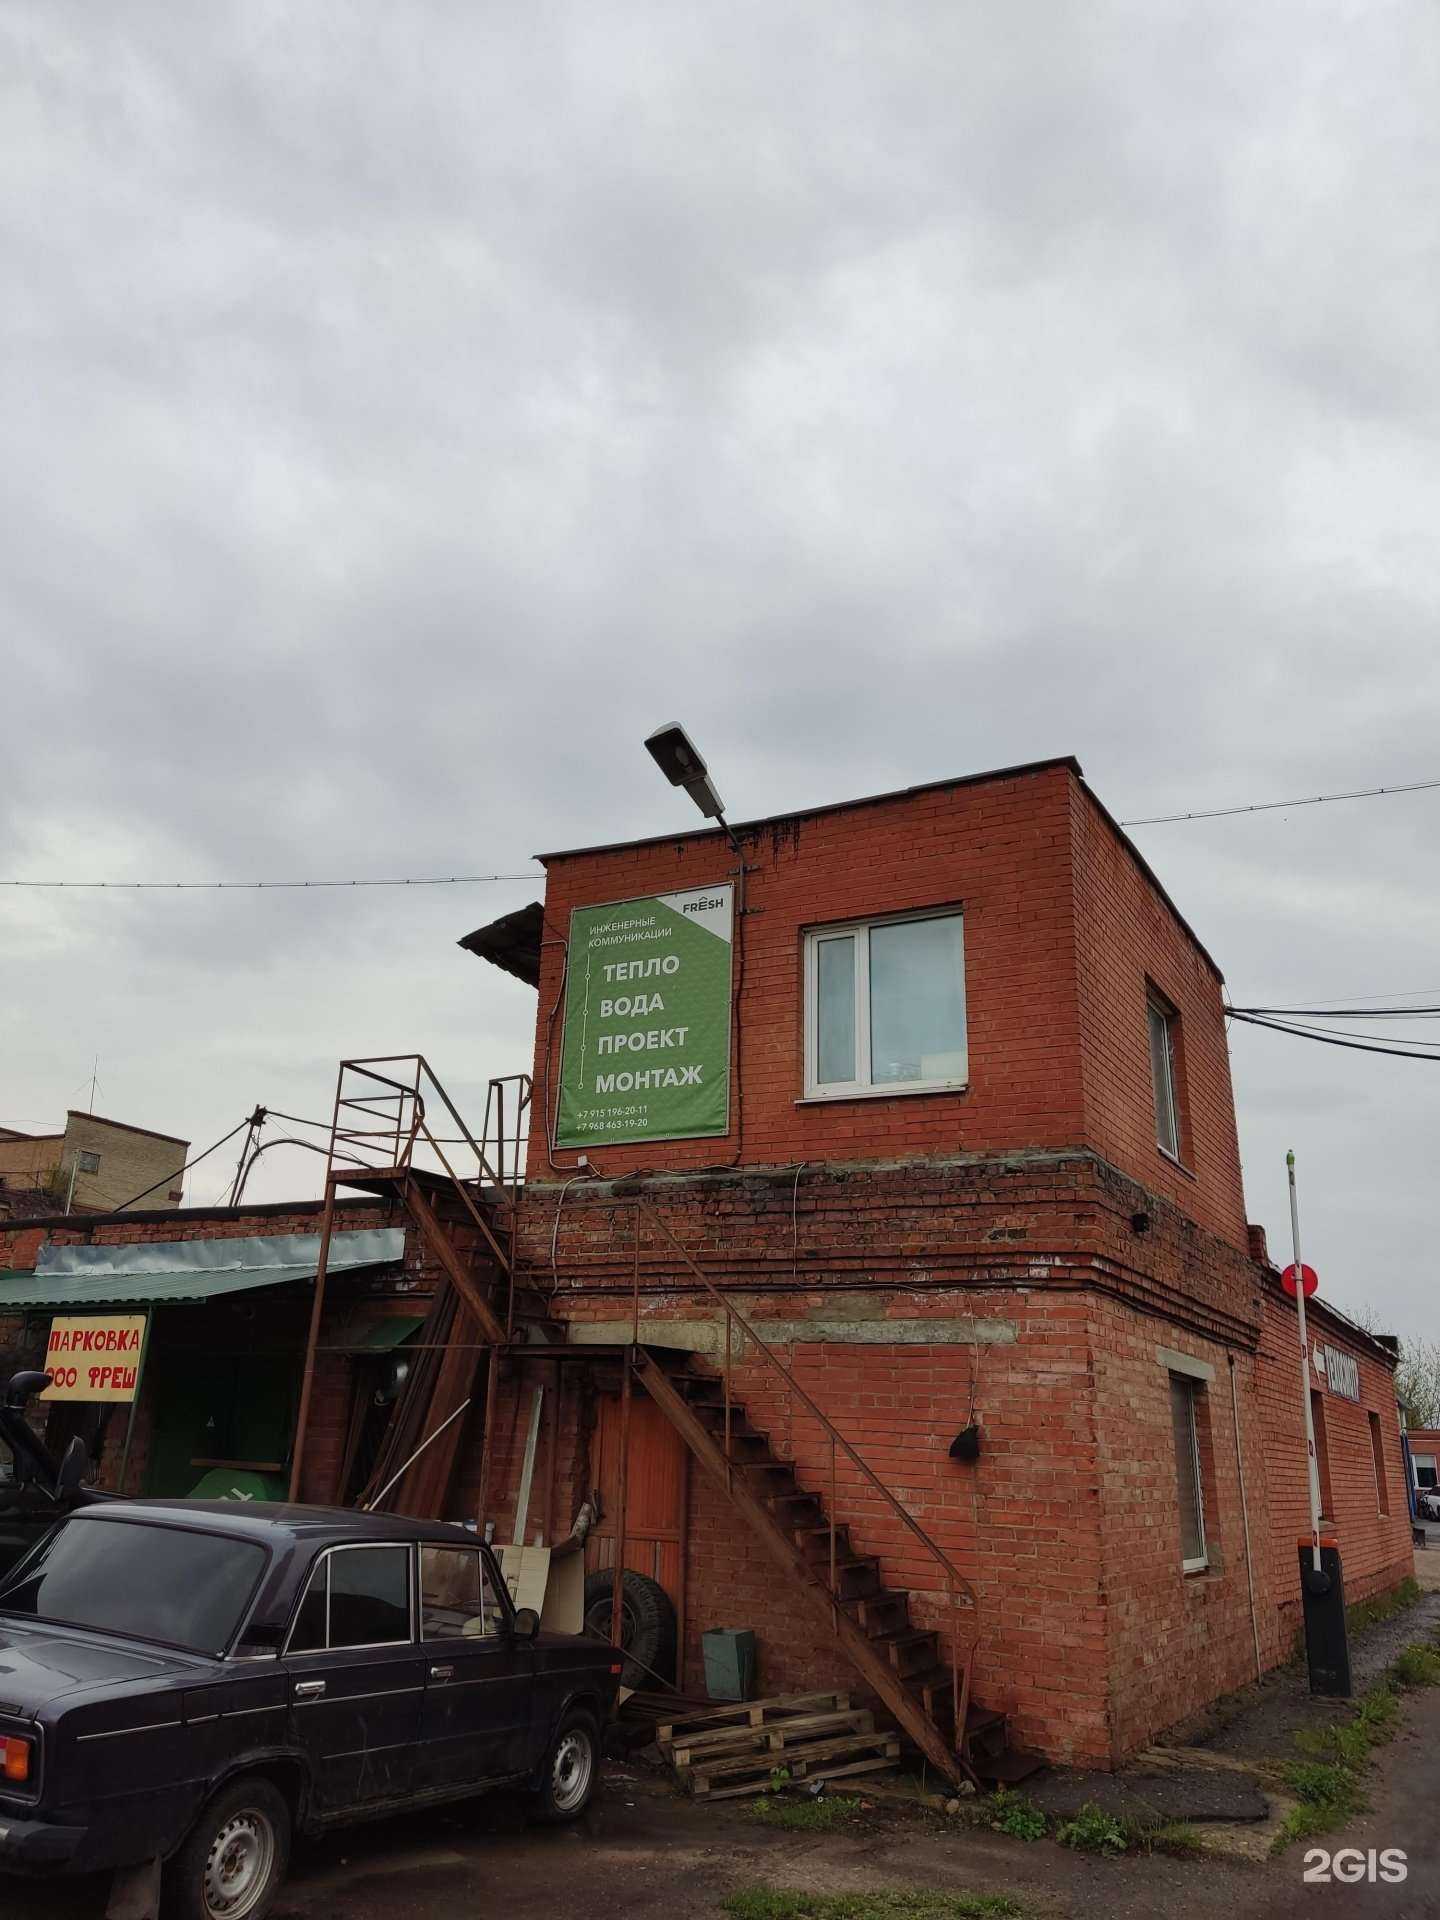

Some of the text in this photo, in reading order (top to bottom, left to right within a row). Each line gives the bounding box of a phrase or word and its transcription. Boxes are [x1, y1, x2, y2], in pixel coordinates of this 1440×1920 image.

[589, 916, 657, 935] ИНЖЕНЕРНЫЕ
[588, 927, 672, 948] КОММУНИКАЦИИ
[603, 955, 680, 983] ТЕПЛО
[600, 992, 665, 1018] ВОДА
[598, 1027, 689, 1056] ПРОЕКТ
[595, 1064, 704, 1094] МОНТАЖ
[576, 1105, 648, 1119] +7 915 196-20-11
[576, 1118, 648, 1132] +7 968 463-19-20
[49, 1328, 140, 1351] ПАРКОВКА
[88, 1366, 138, 1389] ФРЕШ
